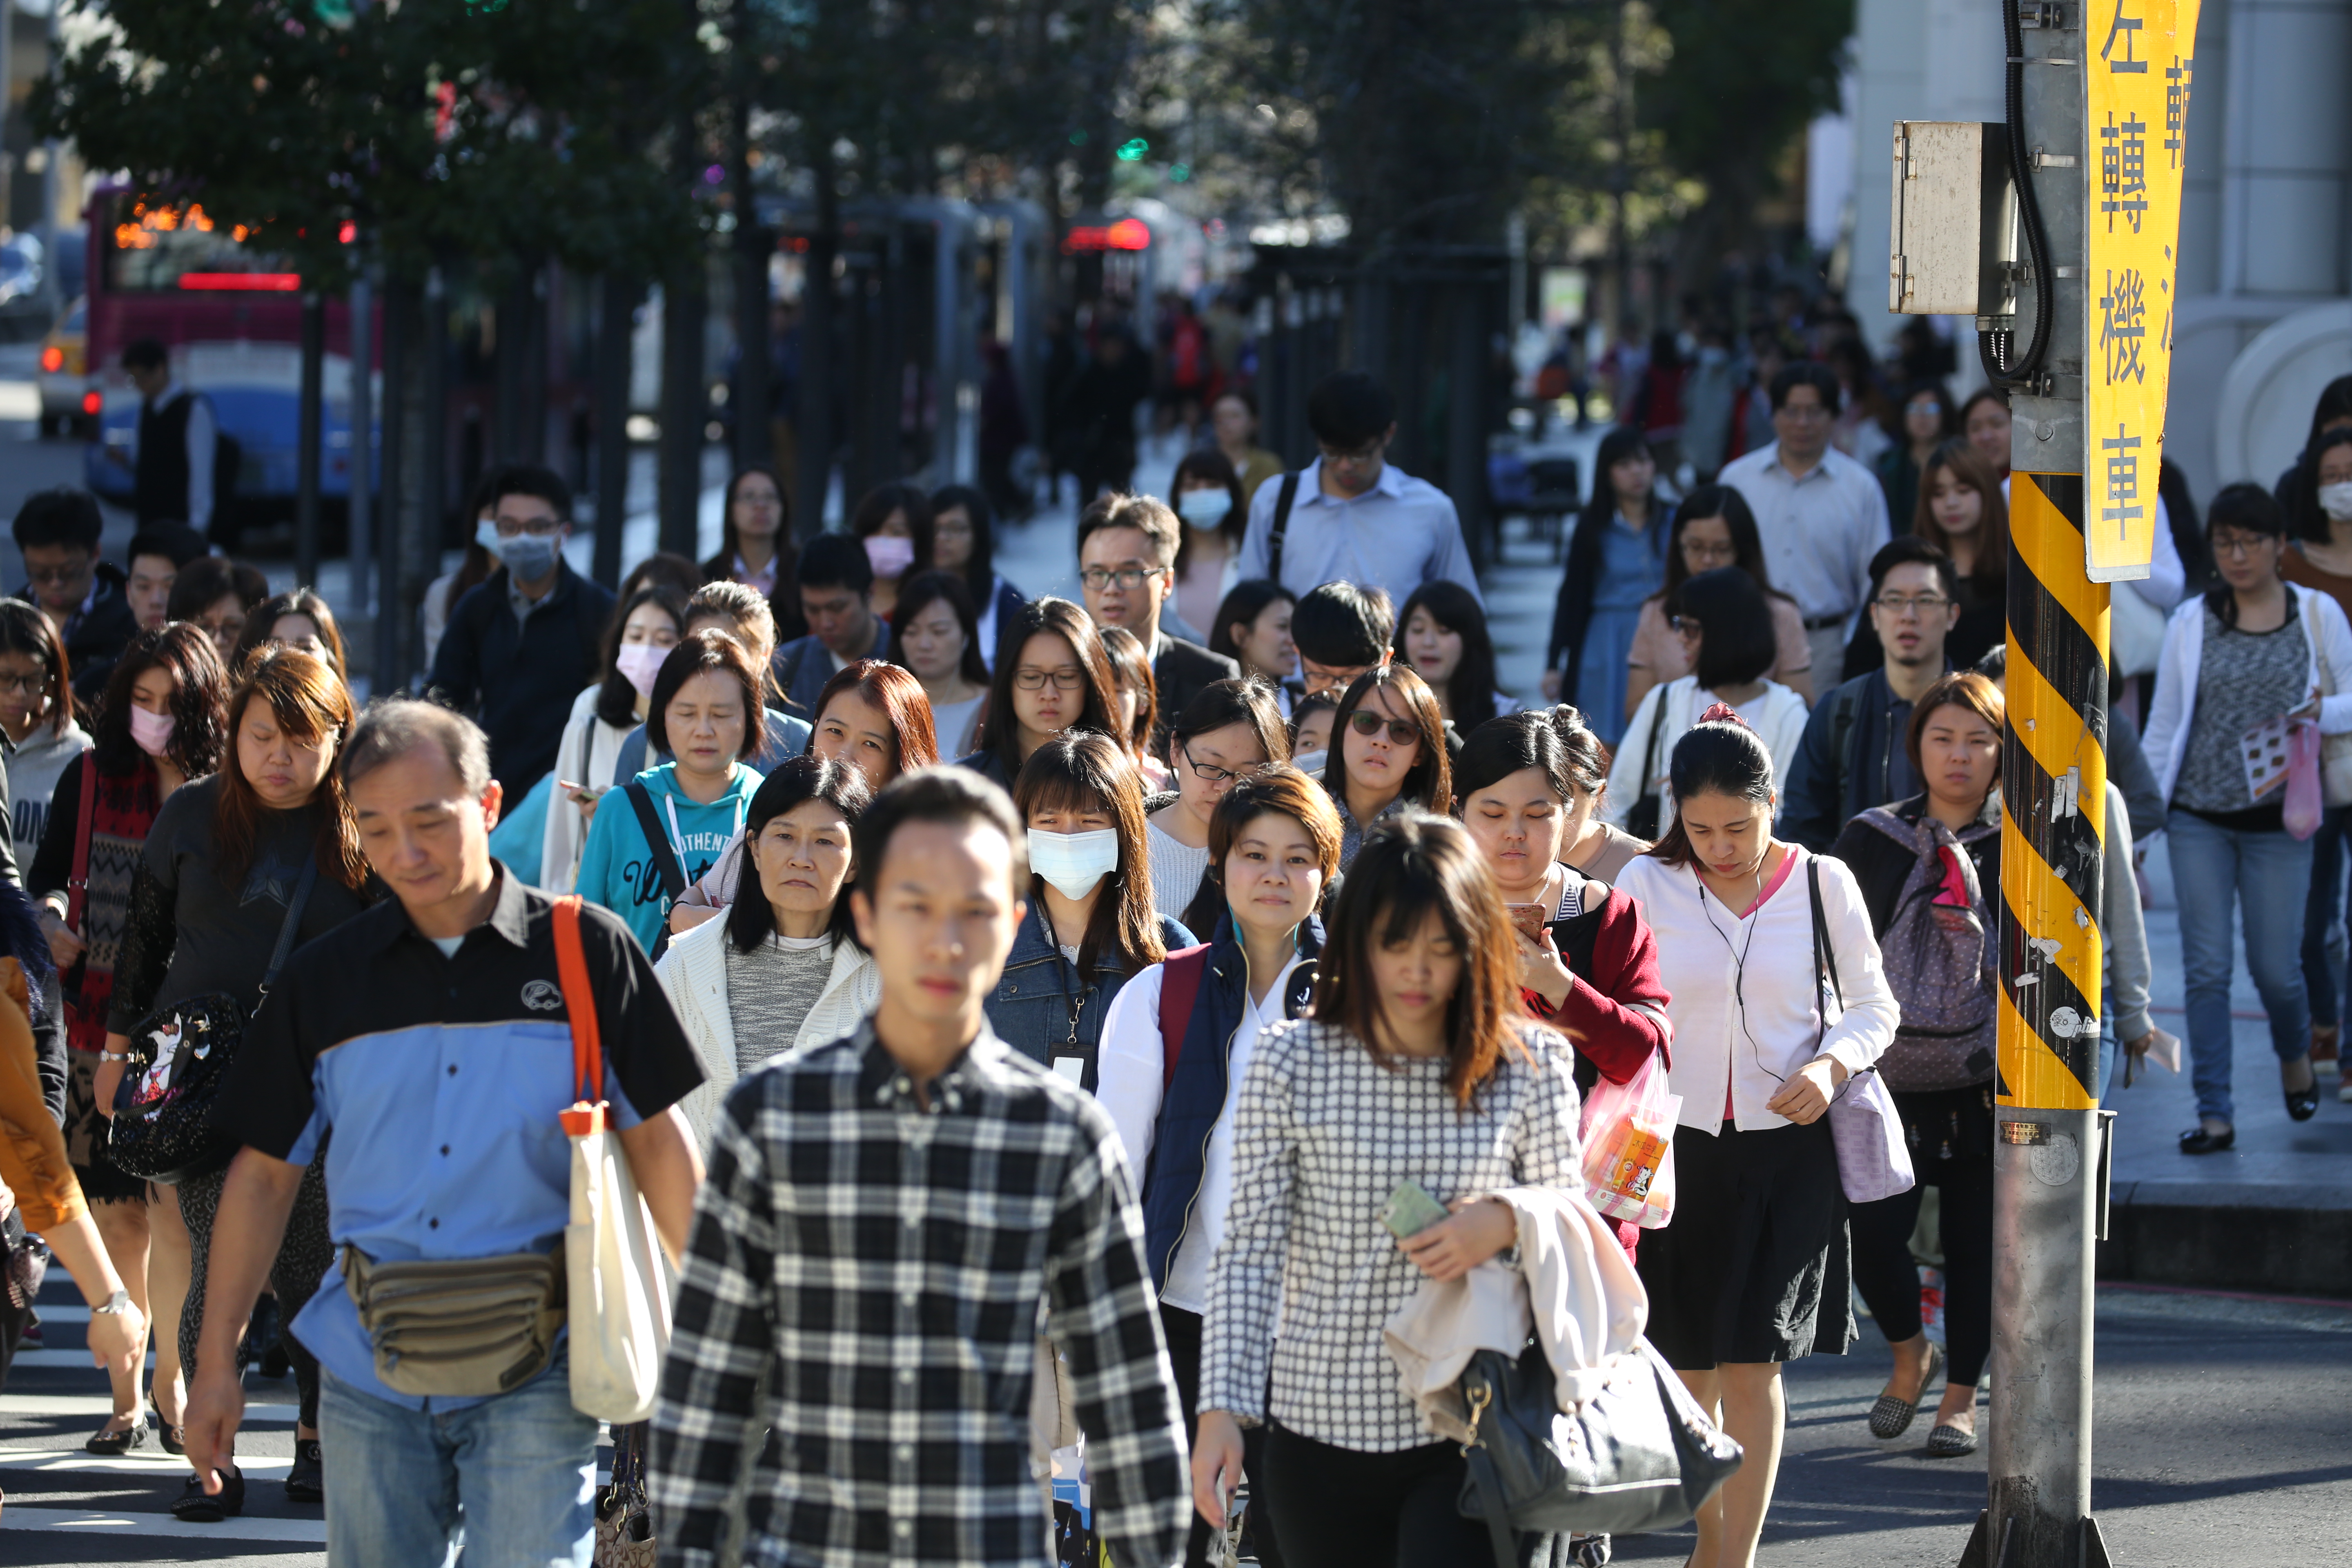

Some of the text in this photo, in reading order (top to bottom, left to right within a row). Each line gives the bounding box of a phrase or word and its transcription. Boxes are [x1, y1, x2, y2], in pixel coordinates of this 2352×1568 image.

[2100, 0, 2148, 541] 左轉機車
[669, 832, 733, 856] UTHENT
